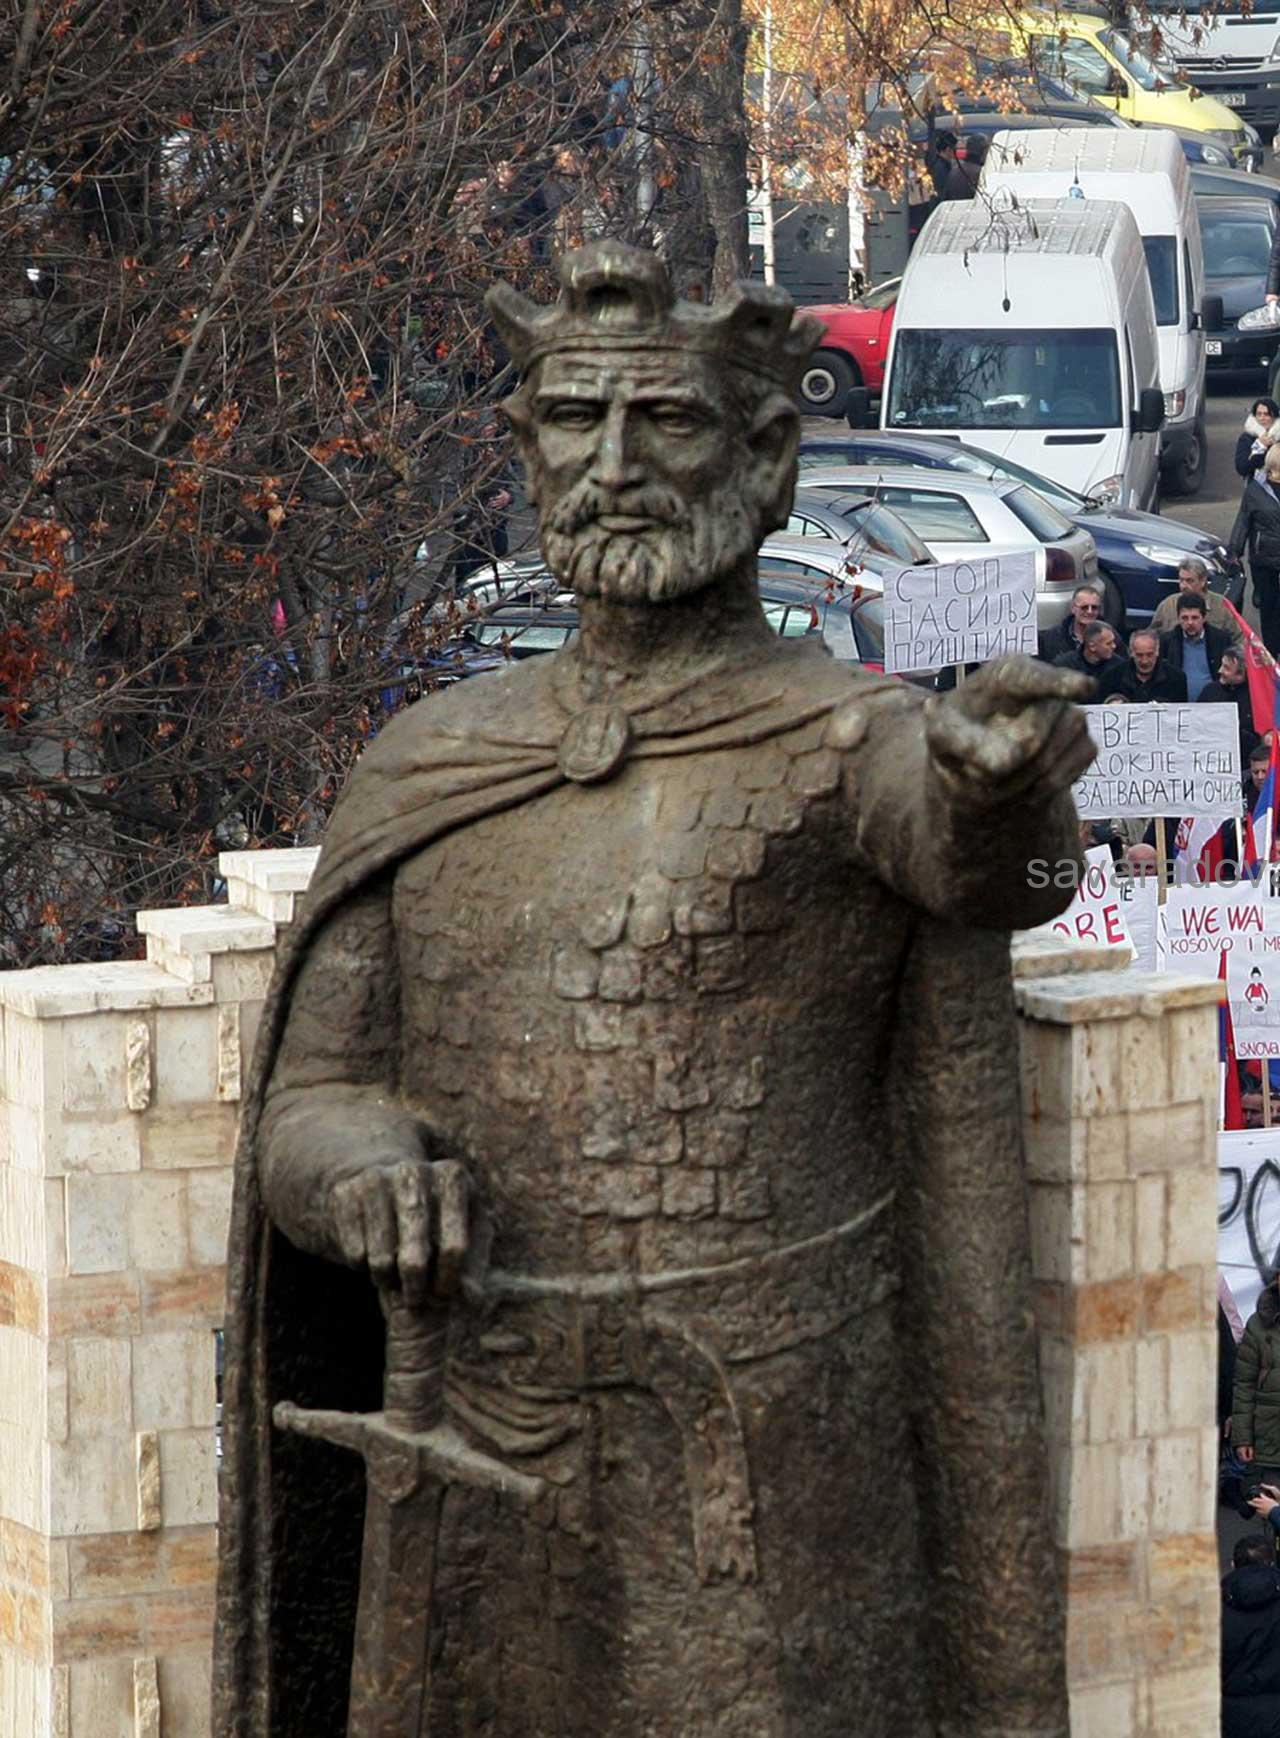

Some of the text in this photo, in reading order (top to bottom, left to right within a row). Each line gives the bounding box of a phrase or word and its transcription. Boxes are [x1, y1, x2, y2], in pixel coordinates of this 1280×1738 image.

[895, 558, 1001, 602] СТОП
[892, 588, 1036, 643] НАСИЉУ
[893, 625, 1035, 669] ПРИШТИНЕ
[1085, 709, 1192, 749] ВЕТЕ
[1077, 778, 1195, 809] ЗАТВАРАТИ
[1181, 905, 1221, 937] WE
[1170, 936, 1233, 955] KOSOVO
